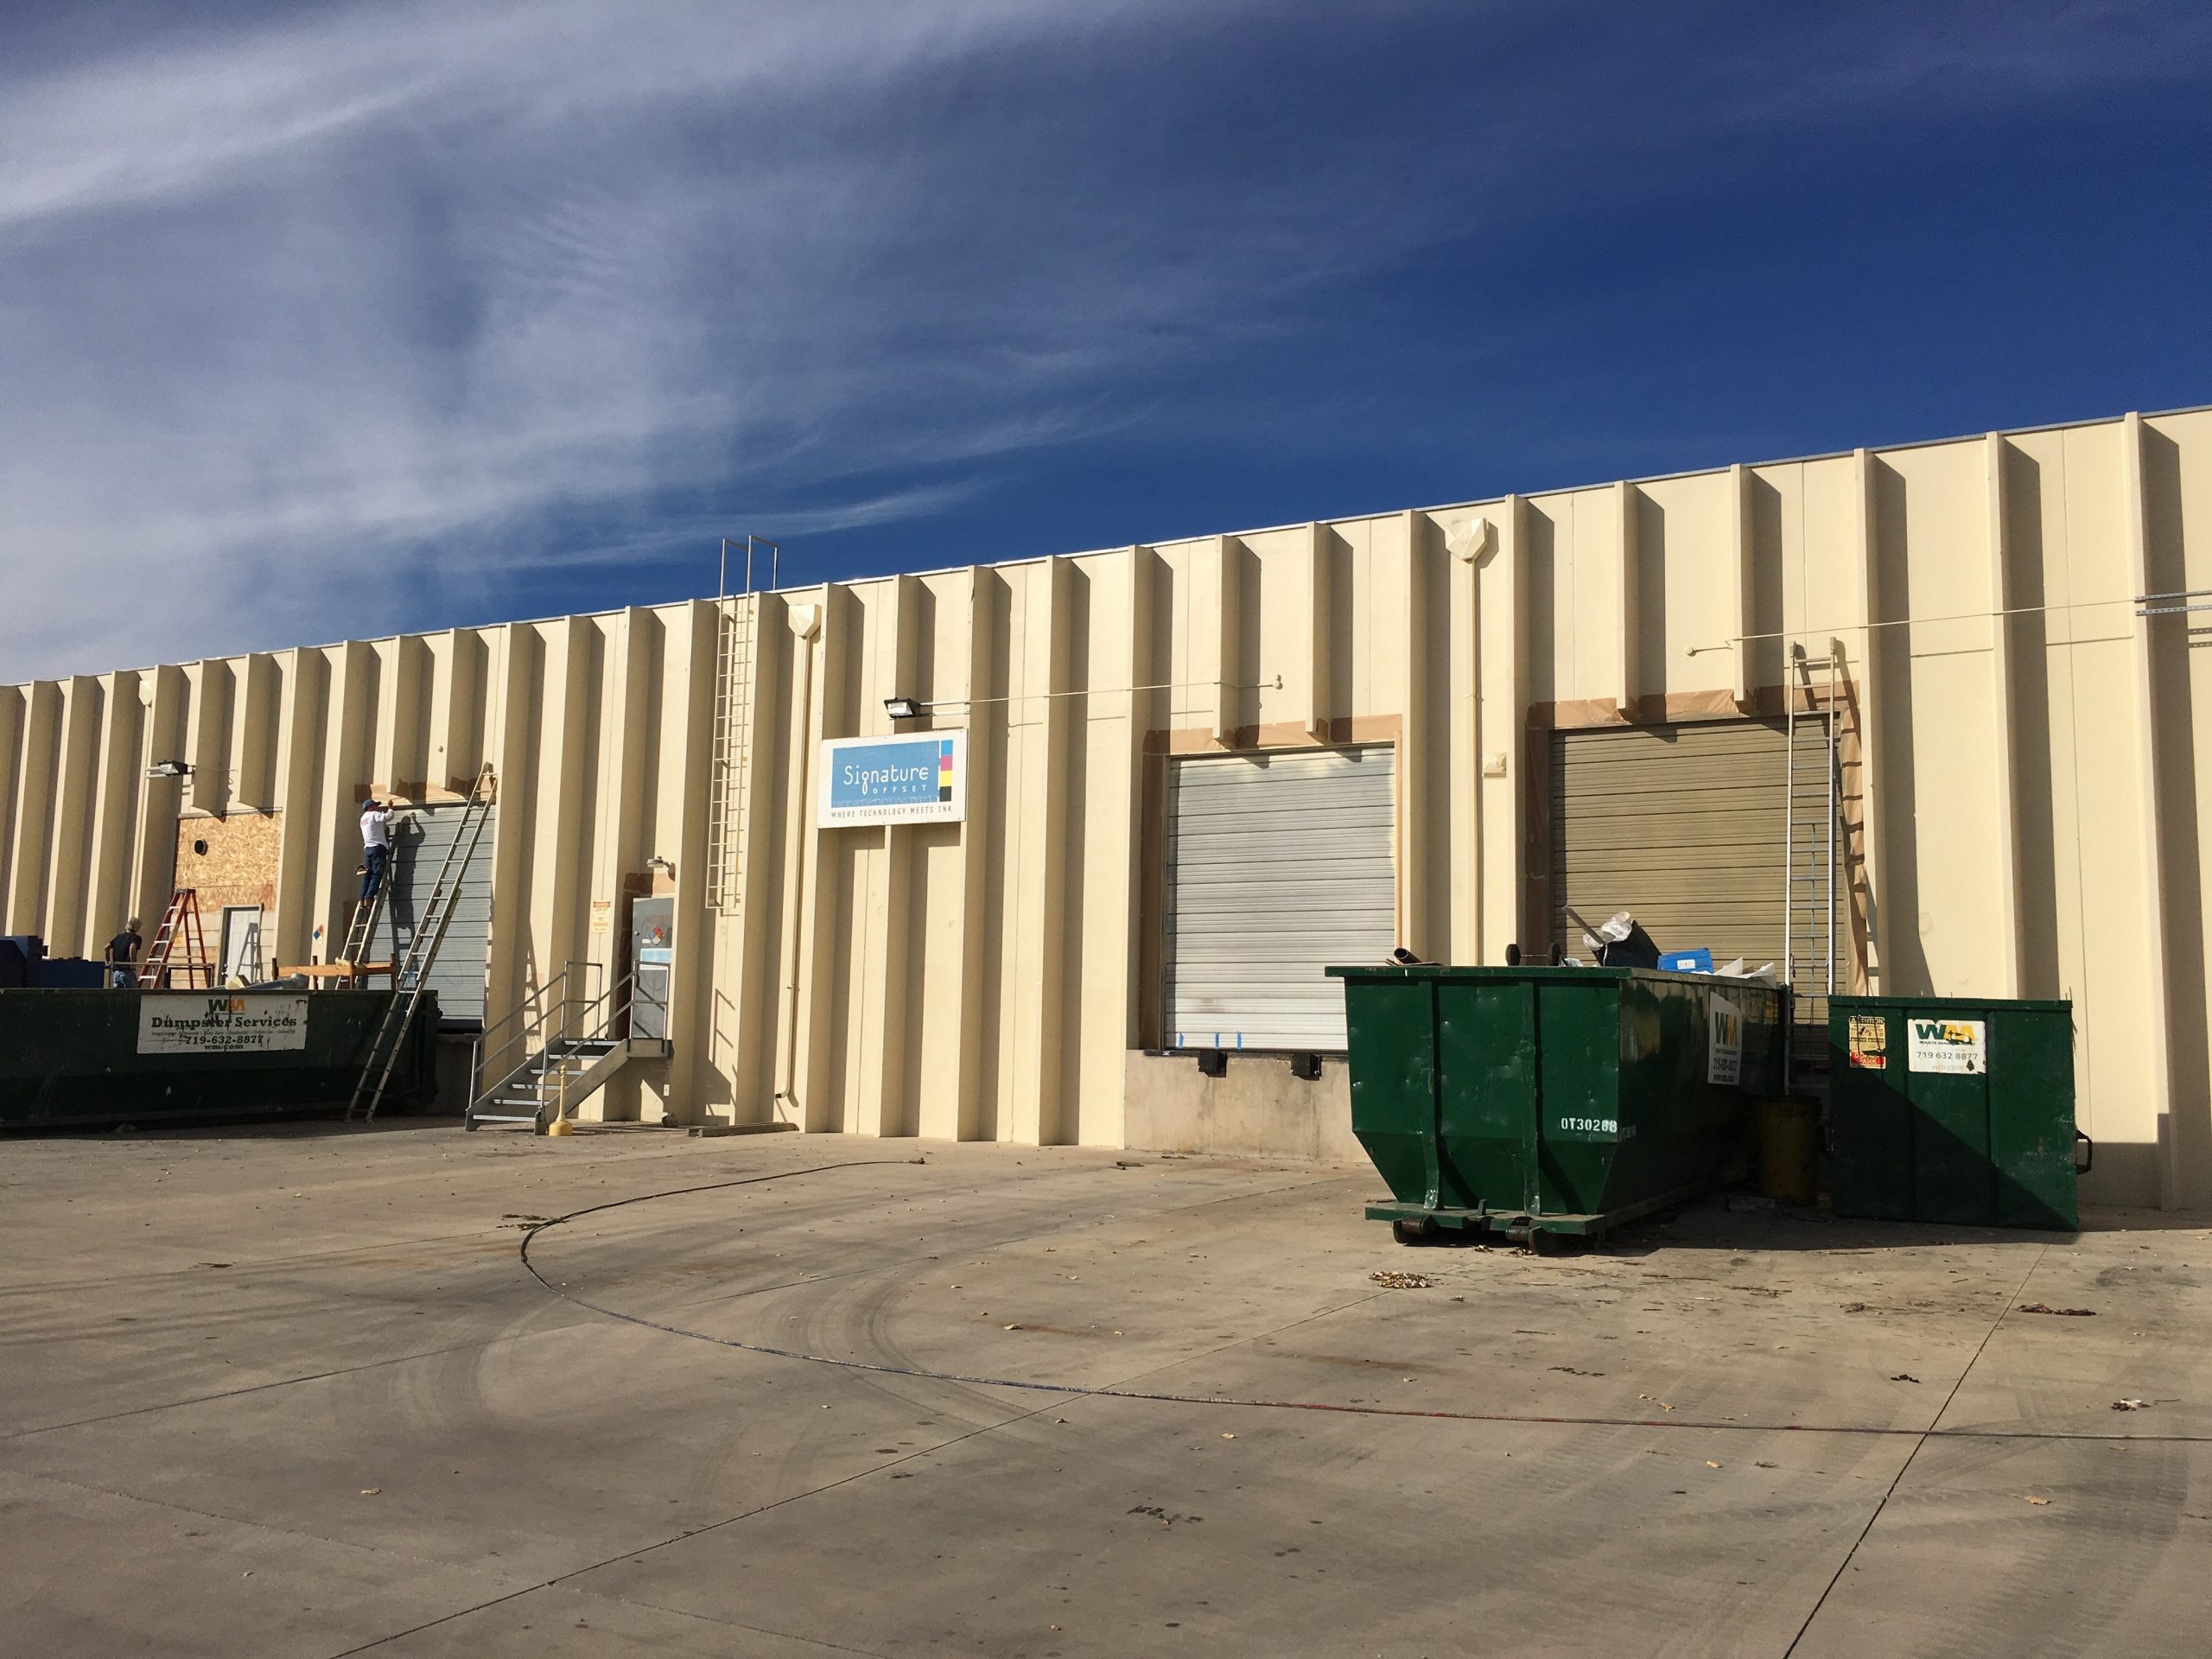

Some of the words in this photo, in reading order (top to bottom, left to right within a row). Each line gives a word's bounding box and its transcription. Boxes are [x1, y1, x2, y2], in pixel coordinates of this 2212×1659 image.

[843, 764, 929, 795] Signature
[873, 785, 927, 795] OFFSET
[860, 808, 906, 817] TECHNOLOGY
[911, 806, 934, 815] MEETS
[235, 1016, 297, 1027] Services
[185, 1035, 263, 1045] 719-632-8877
